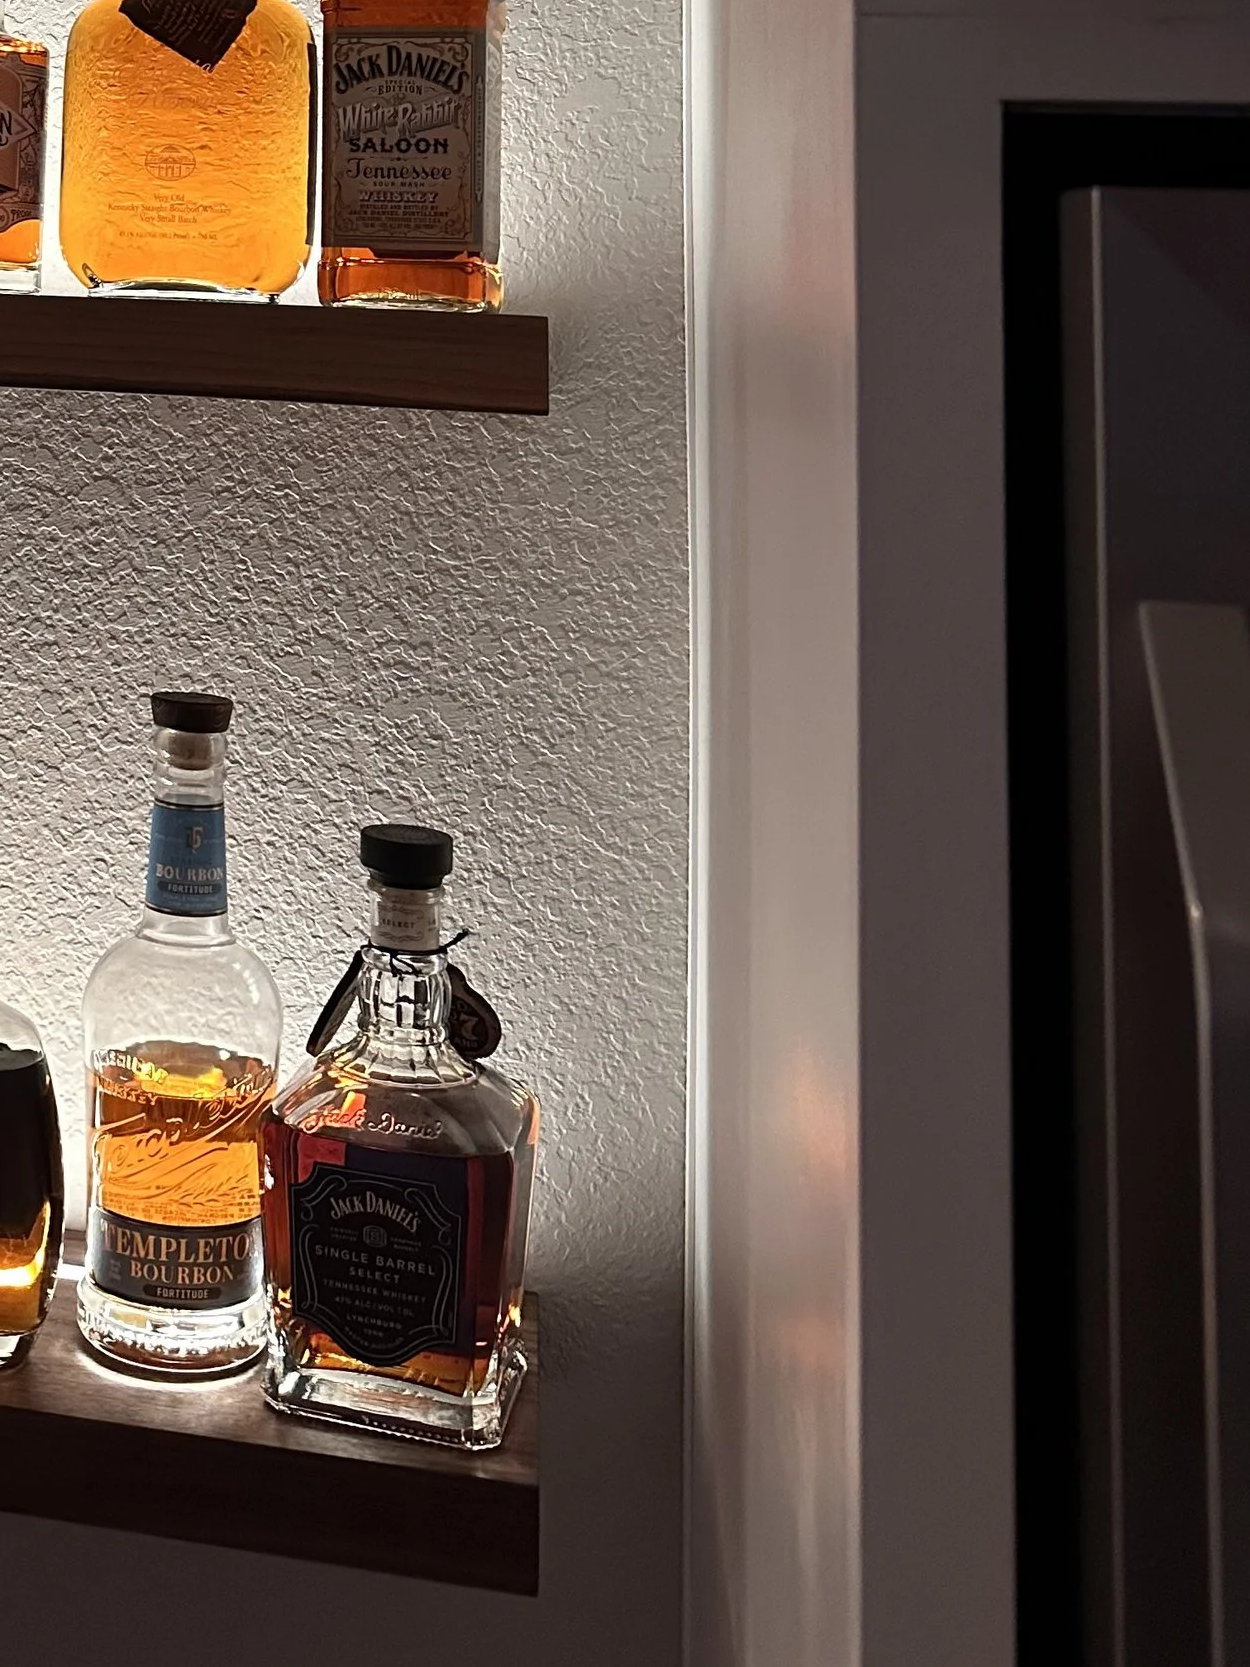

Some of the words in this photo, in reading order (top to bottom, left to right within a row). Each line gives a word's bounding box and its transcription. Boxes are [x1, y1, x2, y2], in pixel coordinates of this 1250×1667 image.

[333, 53, 385, 94] JACK
[387, 45, 470, 94] DANIEL'S
[378, 85, 422, 95] EDITION
[338, 101, 398, 142] White
[398, 95, 462, 138] Rabbit
[350, 137, 449, 154] SALOON
[346, 158, 452, 180] Tennessee
[359, 191, 439, 203] WHISKEY
[108, 203, 139, 213] Kentucky
[170, 204, 200, 213] Bourbon
[155, 863, 223, 882] BOURBON
[168, 883, 213, 893] FORTITUDE
[330, 1194, 365, 1220] JACK
[366, 1191, 422, 1233] DANIEL'S
[315, 1244, 369, 1264] SINGLE
[375, 1255, 436, 1276] BARREL
[130, 1260, 234, 1285] BOURBON
[349, 1266, 400, 1284] SELECT
[157, 1287, 209, 1299] FORTITUDE
[323, 1278, 378, 1296] TENNESSEE
[382, 1289, 427, 1304] WHISKEY
